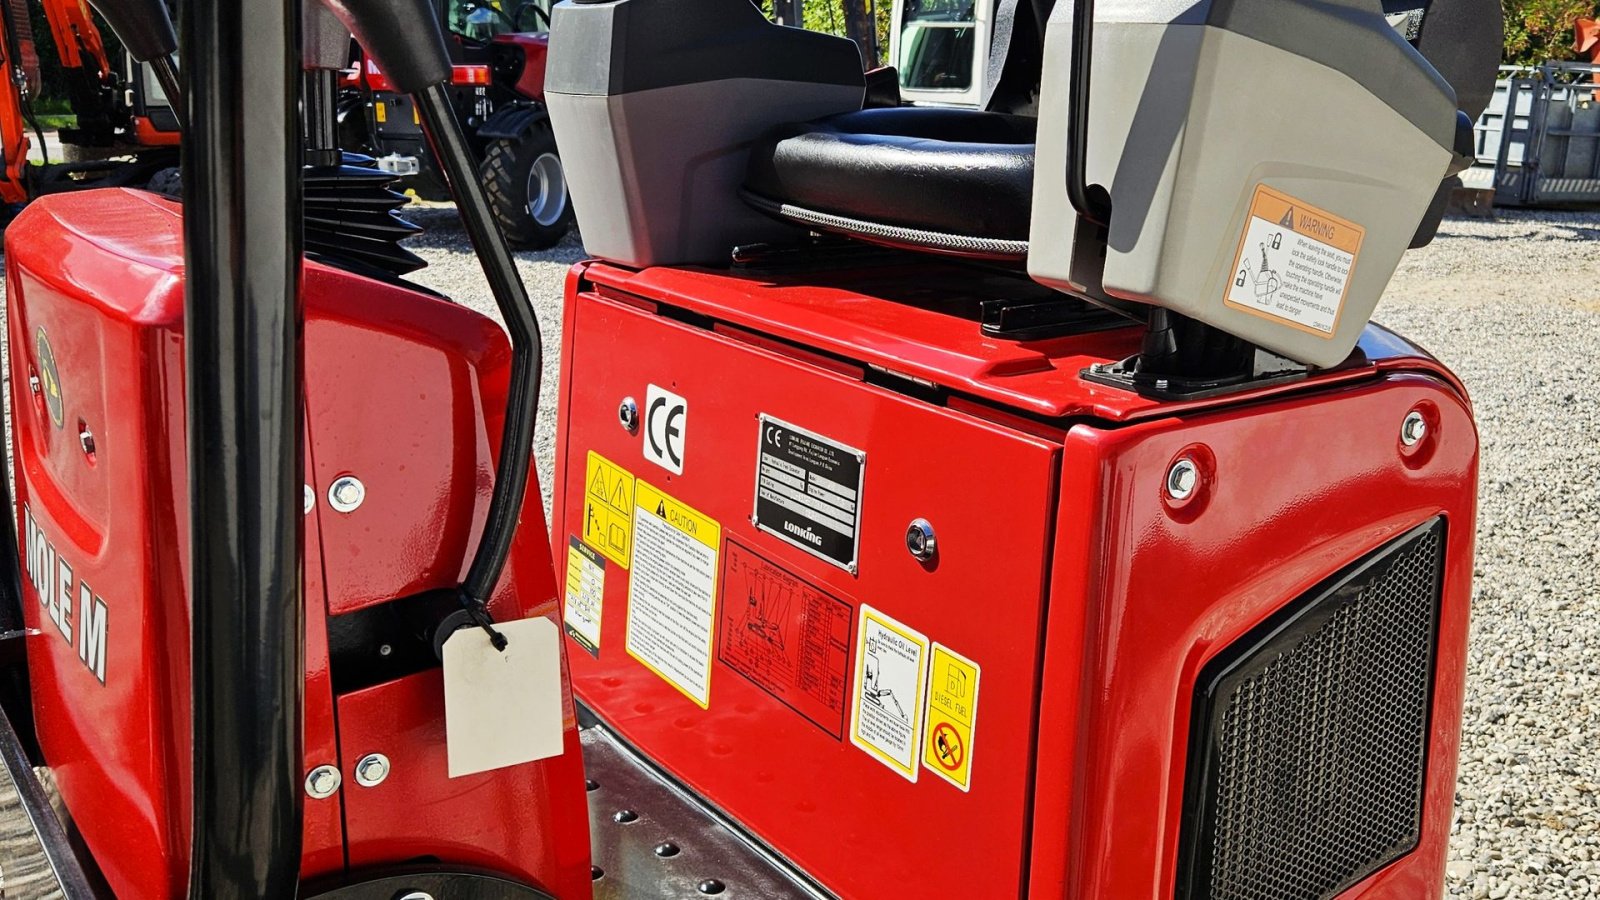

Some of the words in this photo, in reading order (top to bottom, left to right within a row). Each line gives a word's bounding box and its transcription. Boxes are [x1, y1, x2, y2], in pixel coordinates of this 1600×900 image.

[1300, 214, 1335, 240] WARNING
[766, 426, 782, 448] CE
[669, 509, 698, 535] CAUTION
[24, 501, 73, 648] MOLE
[79, 579, 108, 687] M
[878, 629, 897, 647] Hydraulic
[905, 644, 917, 657] Level
[934, 691, 953, 711] DIESEL
[954, 703, 968, 719] FUEL
